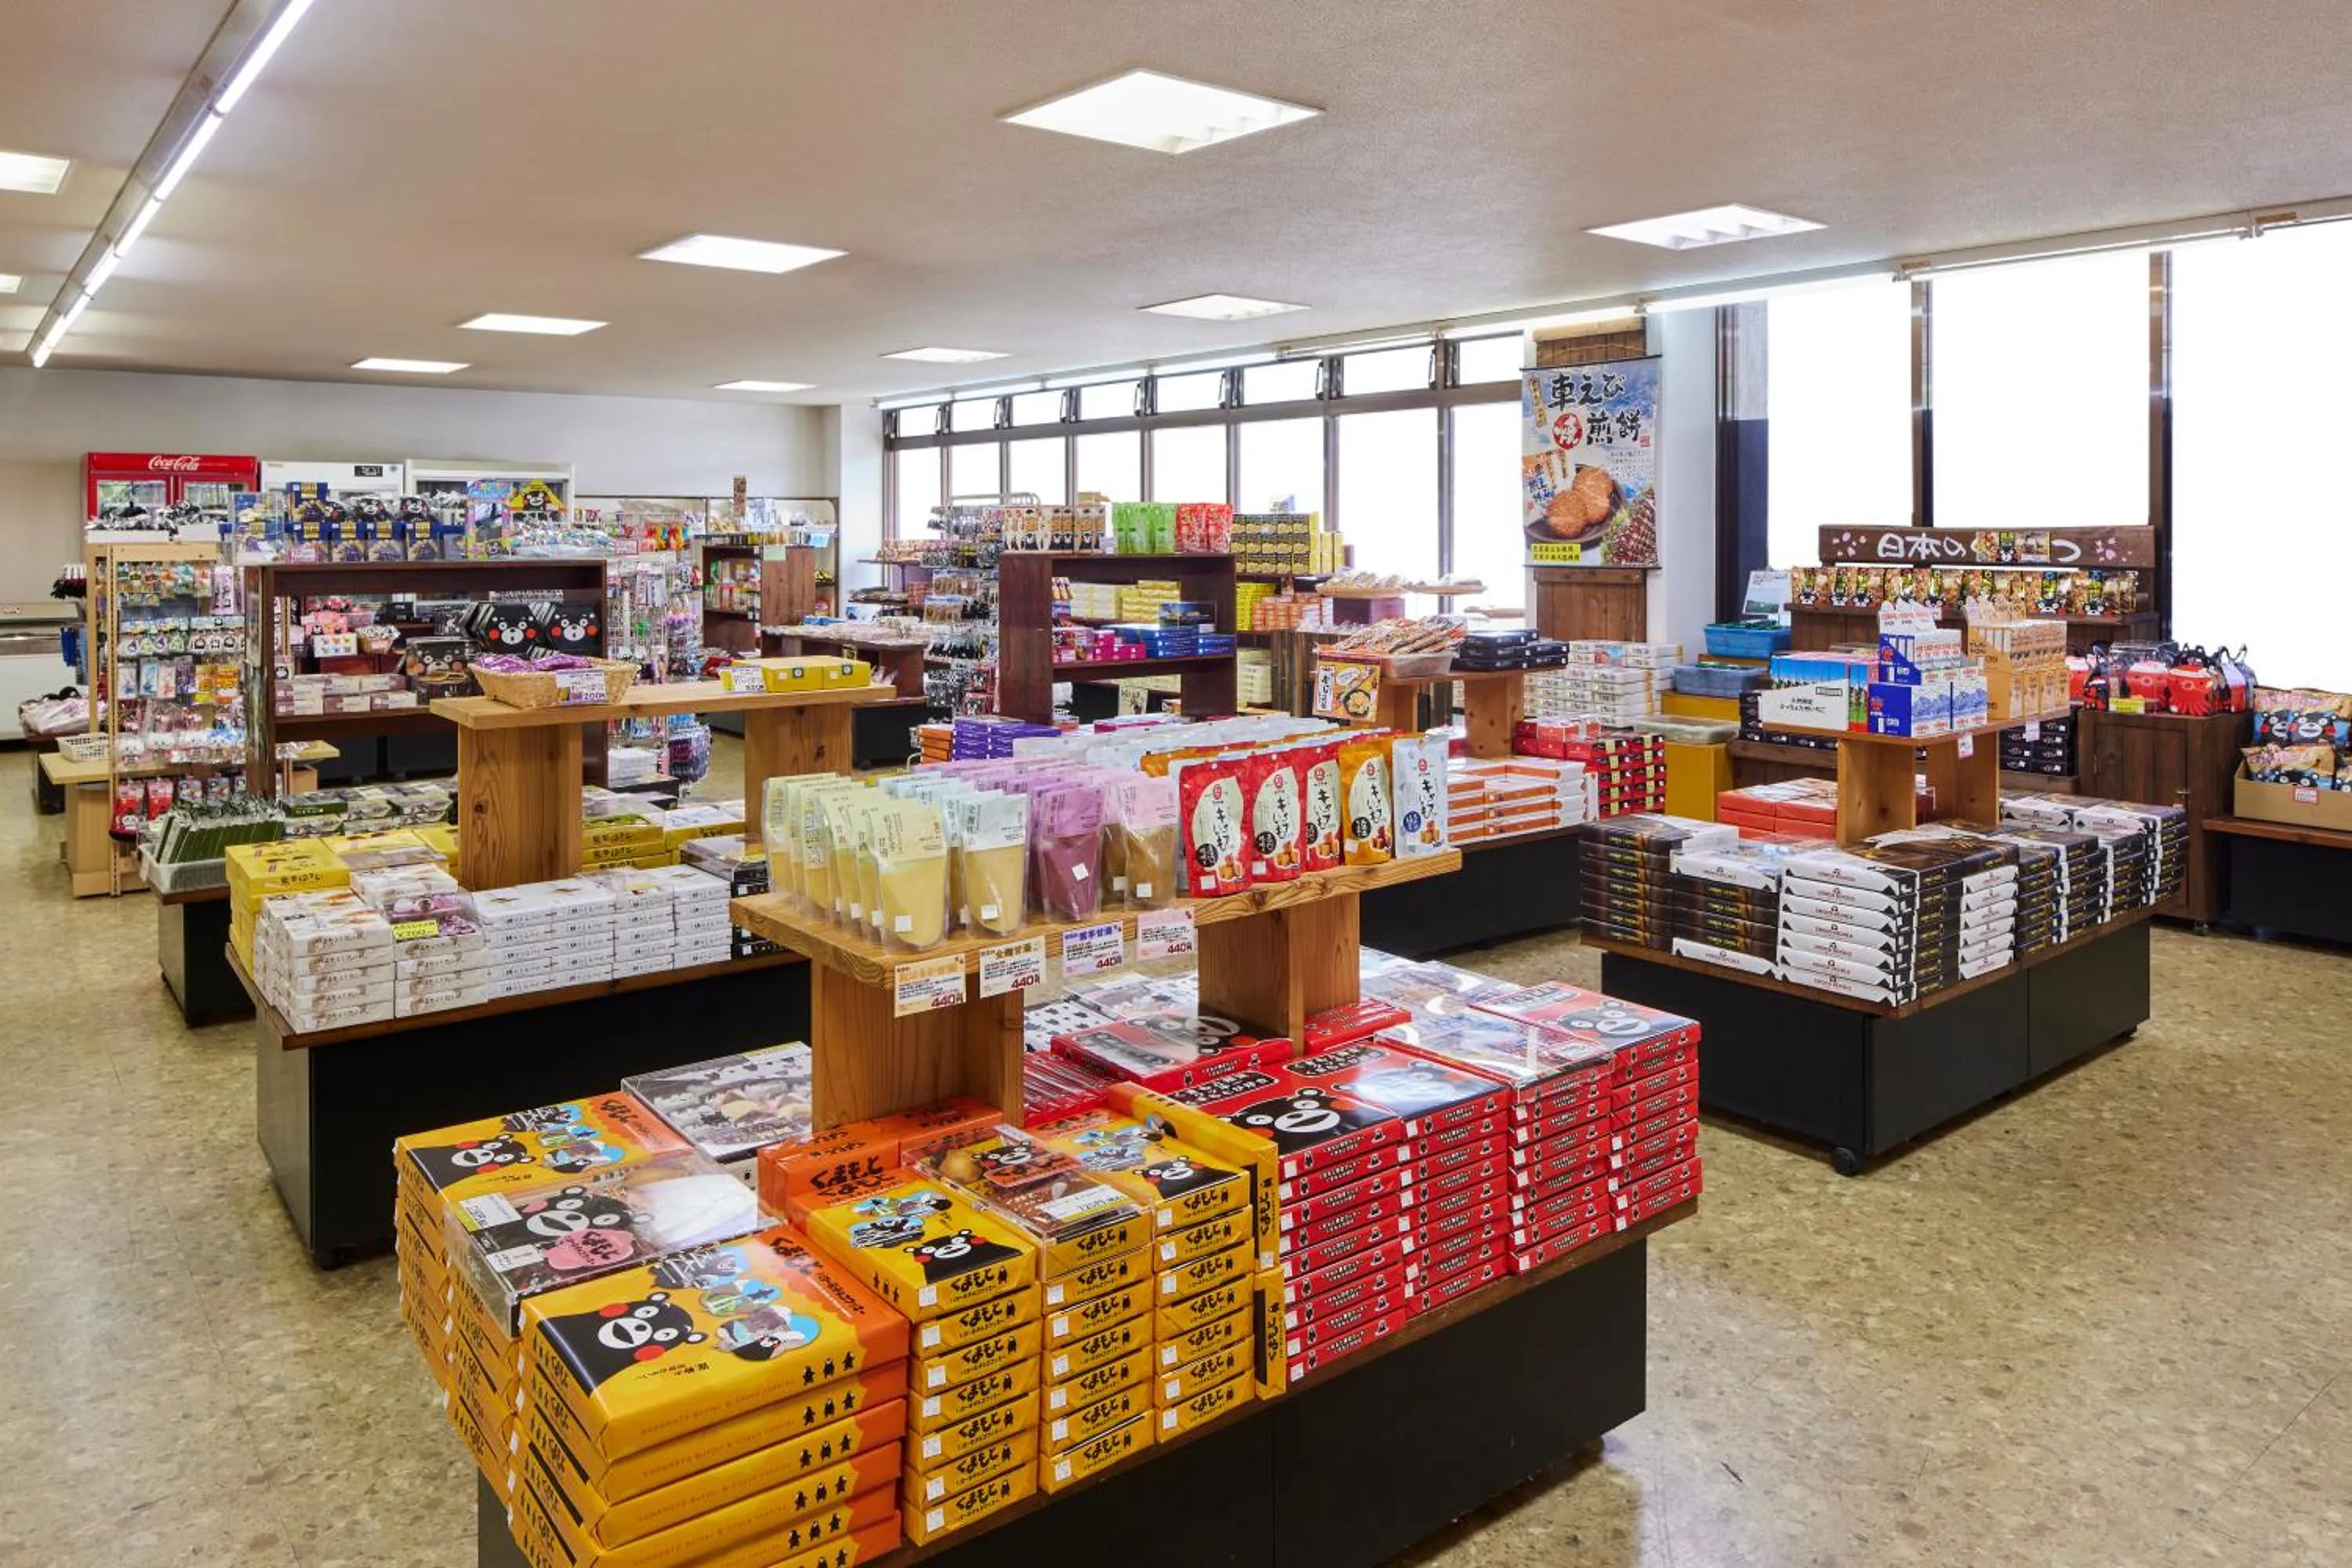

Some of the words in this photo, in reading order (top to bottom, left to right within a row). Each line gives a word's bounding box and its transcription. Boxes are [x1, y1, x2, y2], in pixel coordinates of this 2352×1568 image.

[1077, 1229, 1116, 1250] くまもと
[951, 1269, 995, 1292] くまもと
[1078, 1263, 1116, 1284] くまもと
[960, 1303, 1003, 1327] くまもと
[1081, 1296, 1120, 1319] くまもと
[962, 1339, 1004, 1363] くまもと
[1082, 1331, 1119, 1354] くまもと
[957, 1376, 1000, 1401] くまもと
[1080, 1366, 1117, 1389] くまもと
[1082, 1398, 1119, 1423] くまもと
[959, 1412, 1000, 1438] くまもと
[1083, 1435, 1120, 1459] くまもと
[957, 1448, 999, 1473] くまもと
[956, 1483, 997, 1509] くまもと
